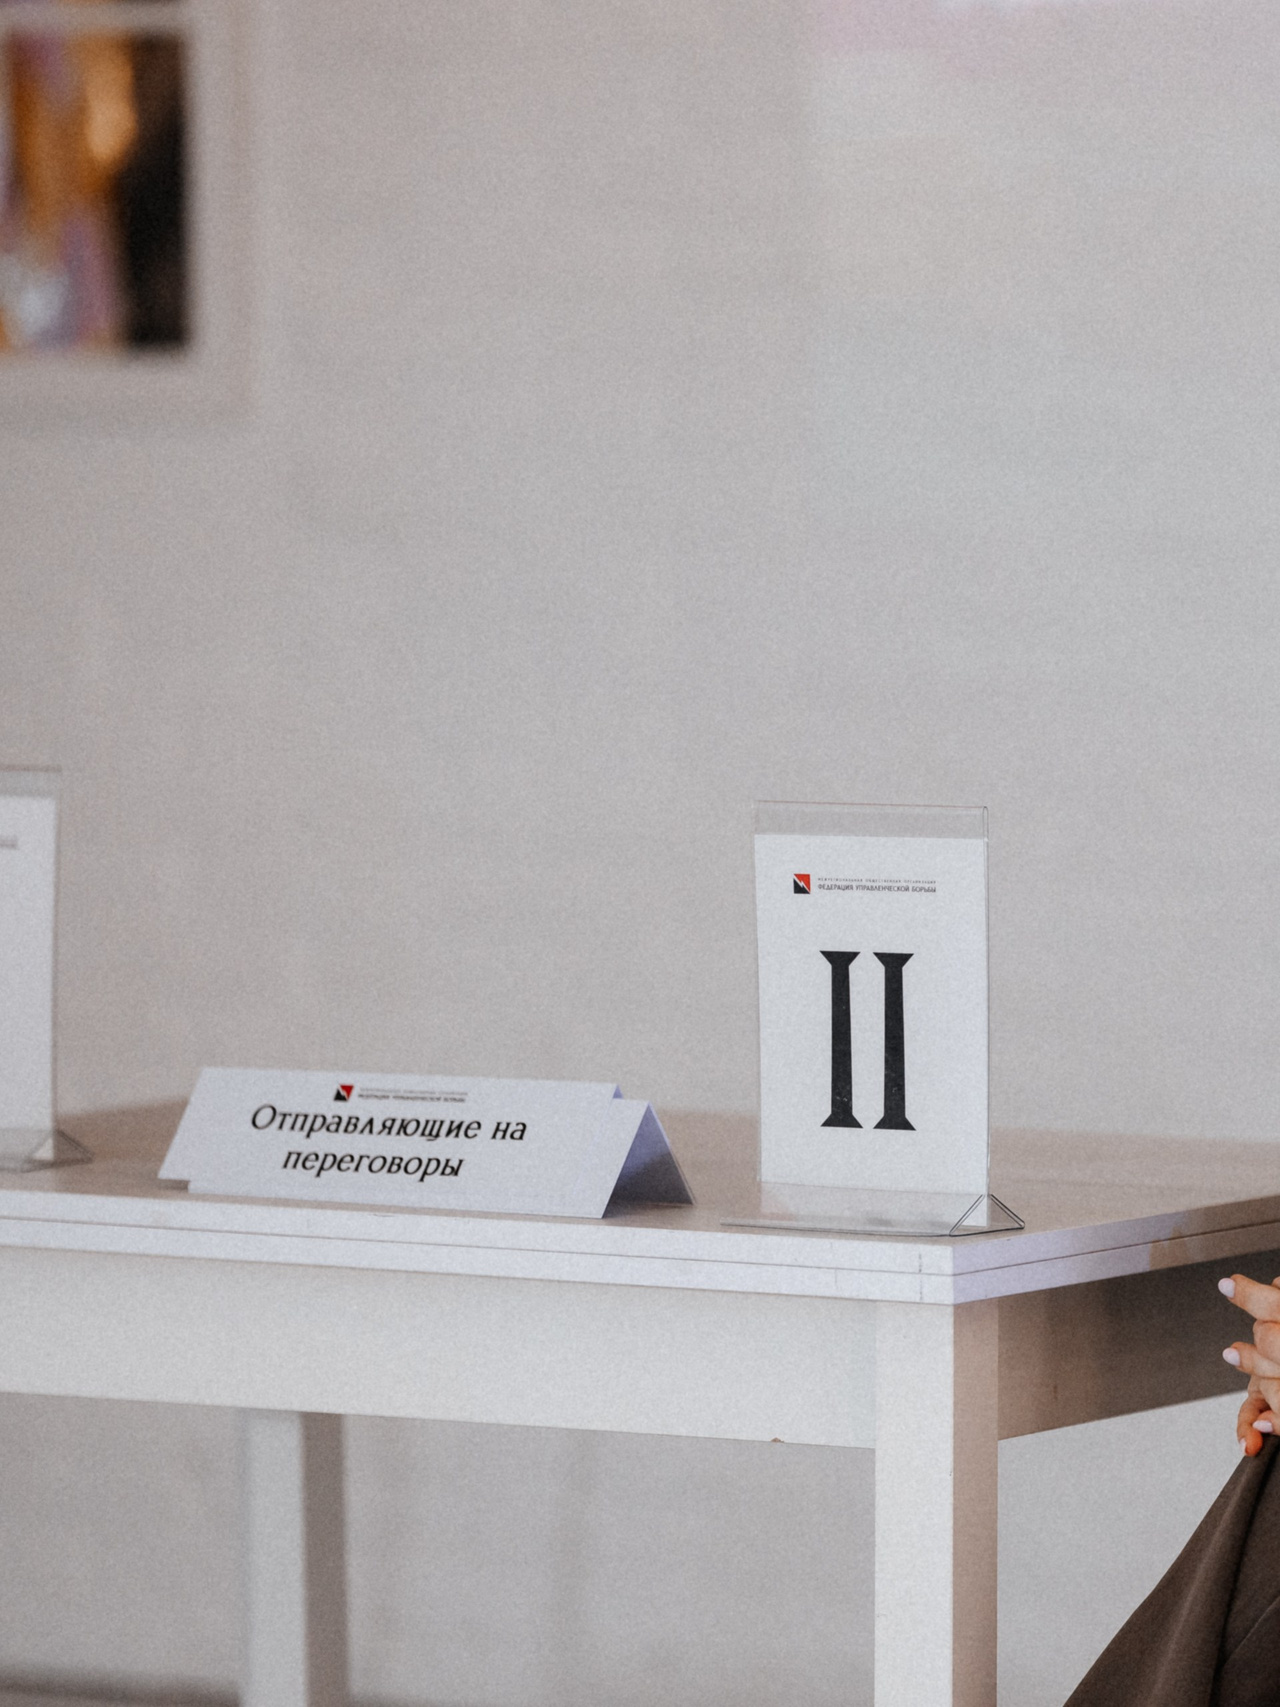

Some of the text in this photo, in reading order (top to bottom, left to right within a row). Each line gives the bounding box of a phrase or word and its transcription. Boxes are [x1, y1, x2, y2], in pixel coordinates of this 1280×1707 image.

[855, 884, 910, 893] УПРАВЛЕНЧЕСКОЙ
[251, 1104, 527, 1141] Отправляющие на
[282, 1151, 464, 1182] переговоры
